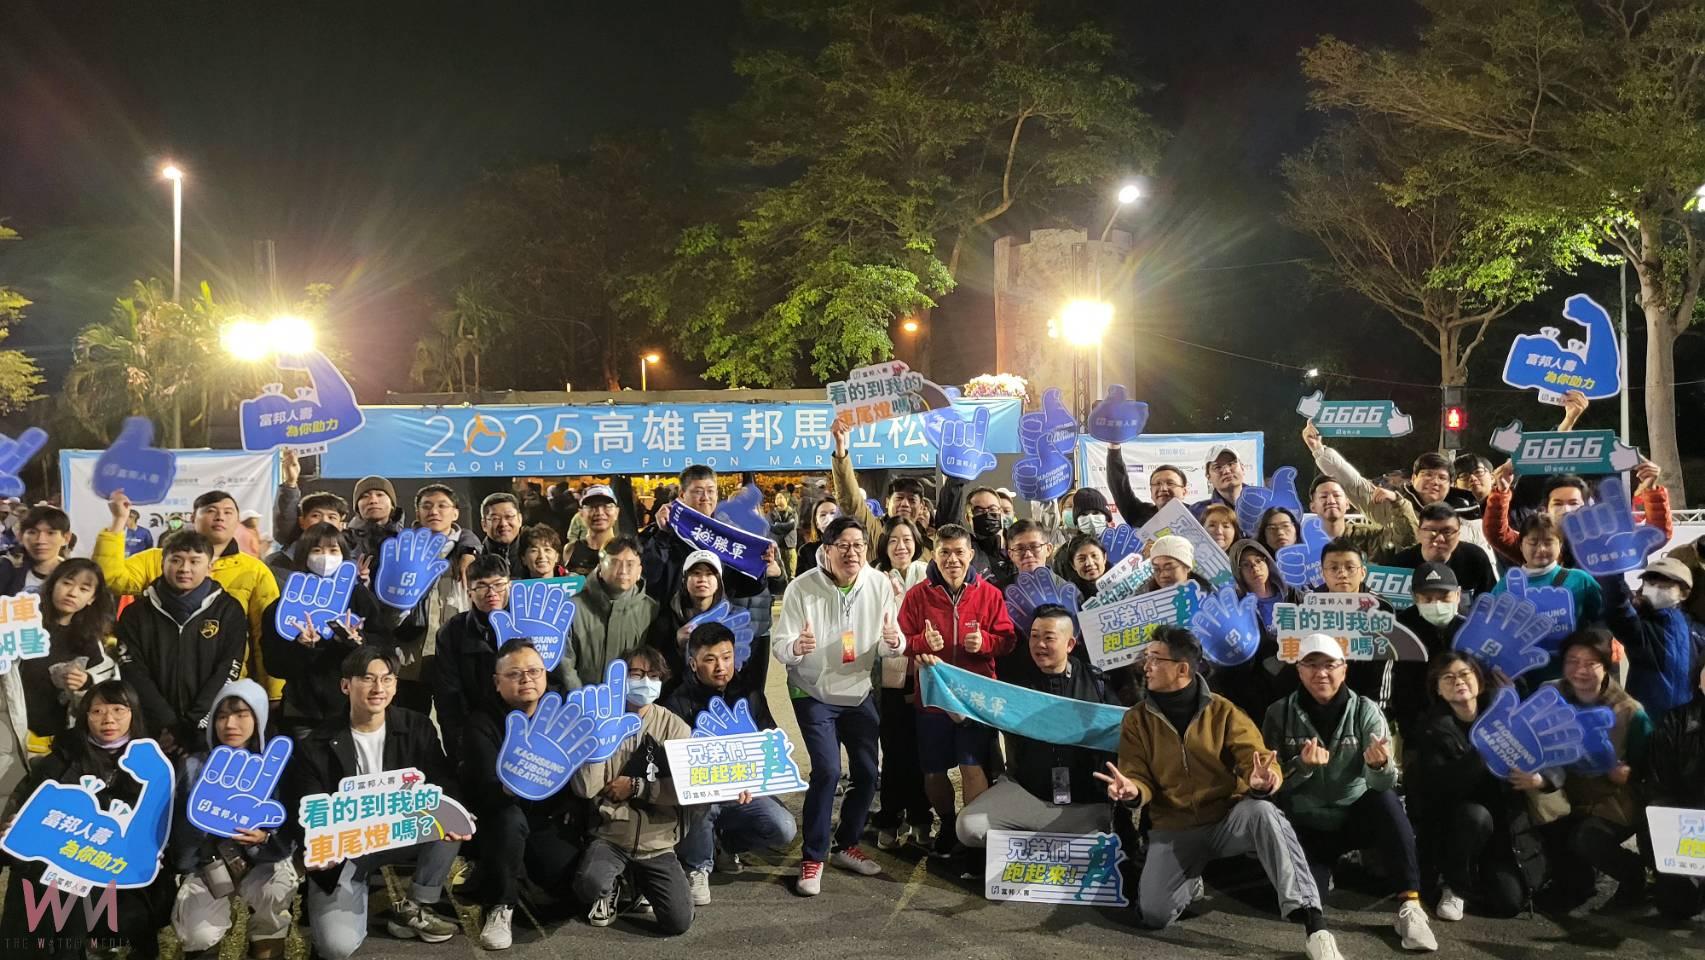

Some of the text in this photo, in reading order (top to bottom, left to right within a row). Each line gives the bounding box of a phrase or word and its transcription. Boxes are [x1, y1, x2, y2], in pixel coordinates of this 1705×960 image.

[1525, 353, 1578, 372] 富邦人壽
[830, 376, 921, 405] 看的到我的
[1544, 370, 1597, 390] 為你助力
[259, 406, 313, 427] 富邦人壽
[1319, 406, 1384, 424] 6666
[286, 418, 339, 437] 為你助力
[424, 411, 583, 457] 2025
[1521, 437, 1605, 459] 6666
[424, 453, 929, 473] KAOHSIUNG FUBON MARTHON
[1099, 599, 1159, 633] 兄弟們
[1276, 606, 1392, 633] 看的到我的
[686, 742, 748, 765] 兄弟們
[1490, 731, 1521, 760] FUBON
[513, 746, 566, 774] KAOHSIUNG
[517, 759, 552, 777] FUBON
[357, 776, 396, 790] 富邦人壽
[502, 761, 555, 788] MARATHON
[690, 762, 758, 786] 跑起來!
[303, 788, 439, 829] 看的到我的
[41, 809, 114, 846] 富邦人壽
[309, 817, 435, 864] 車尾燈嗎?
[1007, 838, 1066, 862] 兄弟們
[59, 839, 129, 875] 為你助力
[1002, 862, 1057, 884] 跑起來!
